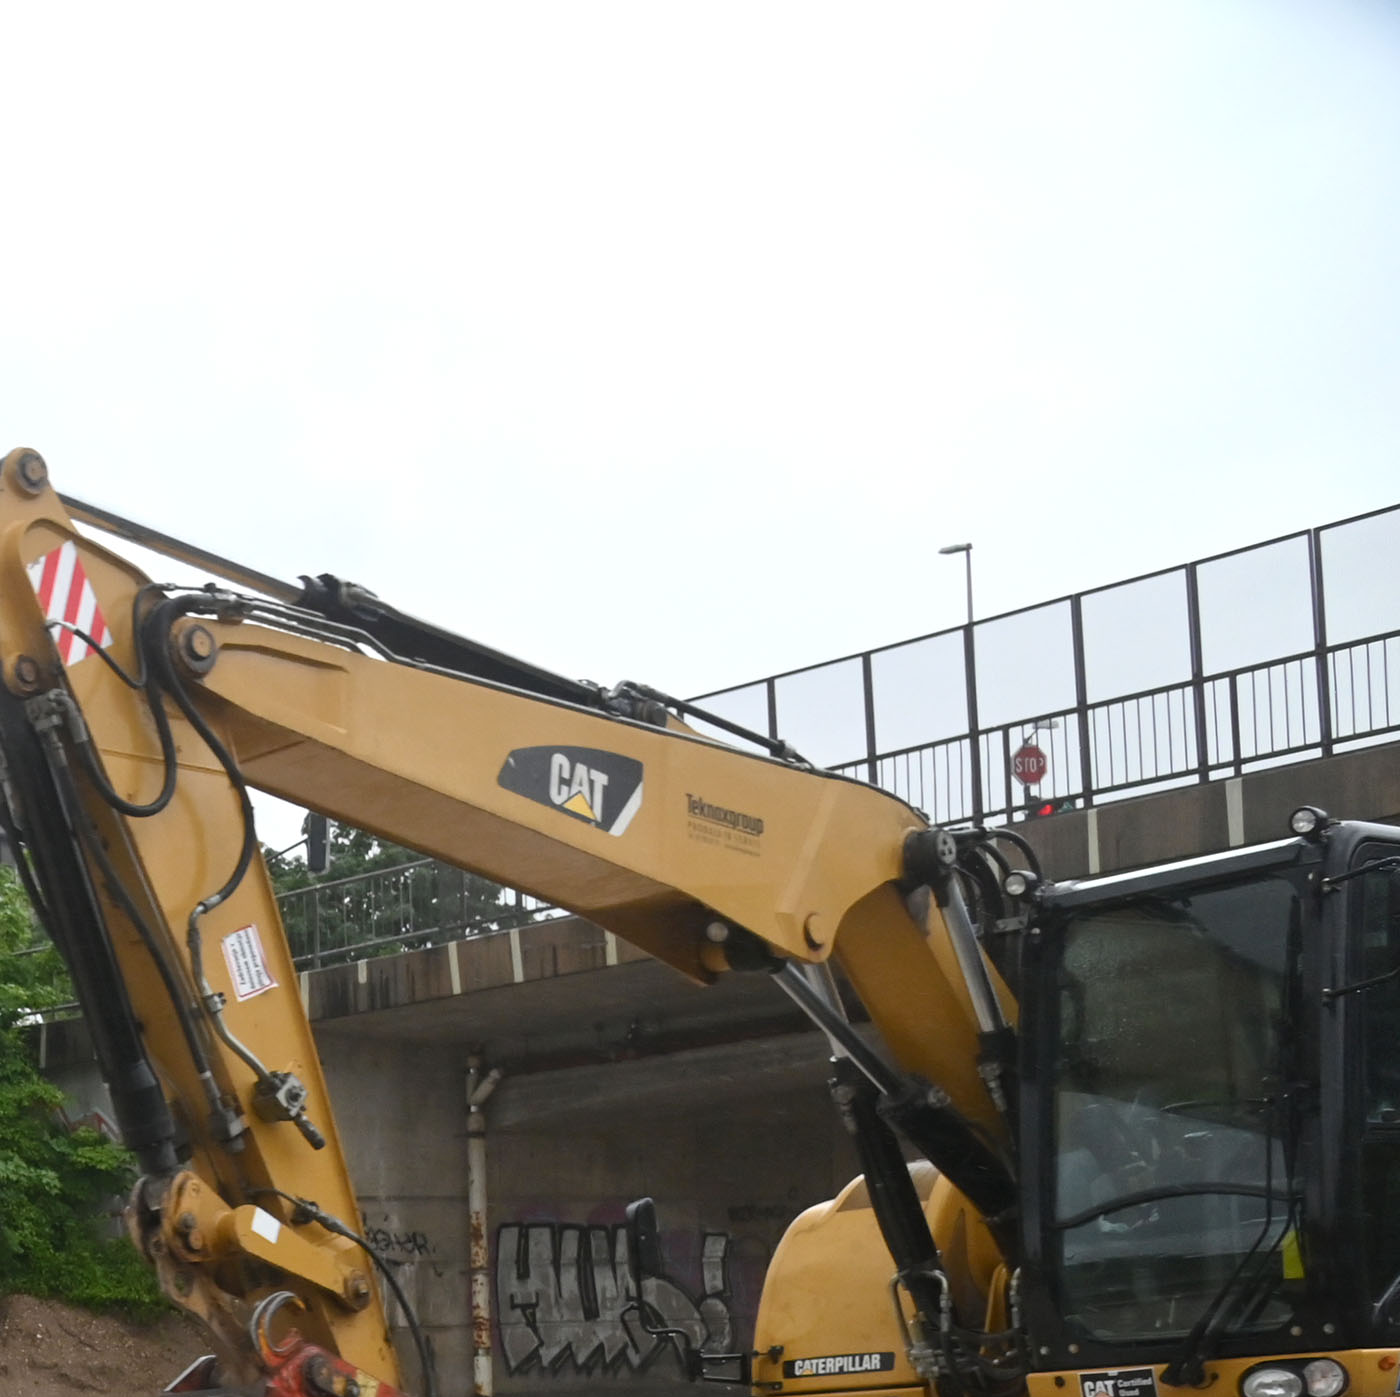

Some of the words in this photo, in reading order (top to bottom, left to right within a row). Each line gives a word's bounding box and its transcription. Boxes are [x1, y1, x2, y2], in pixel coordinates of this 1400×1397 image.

[549, 753, 608, 822] CAT
[794, 1353, 881, 1376] CATERPILLAR
[1116, 1377, 1153, 1388] Certified
